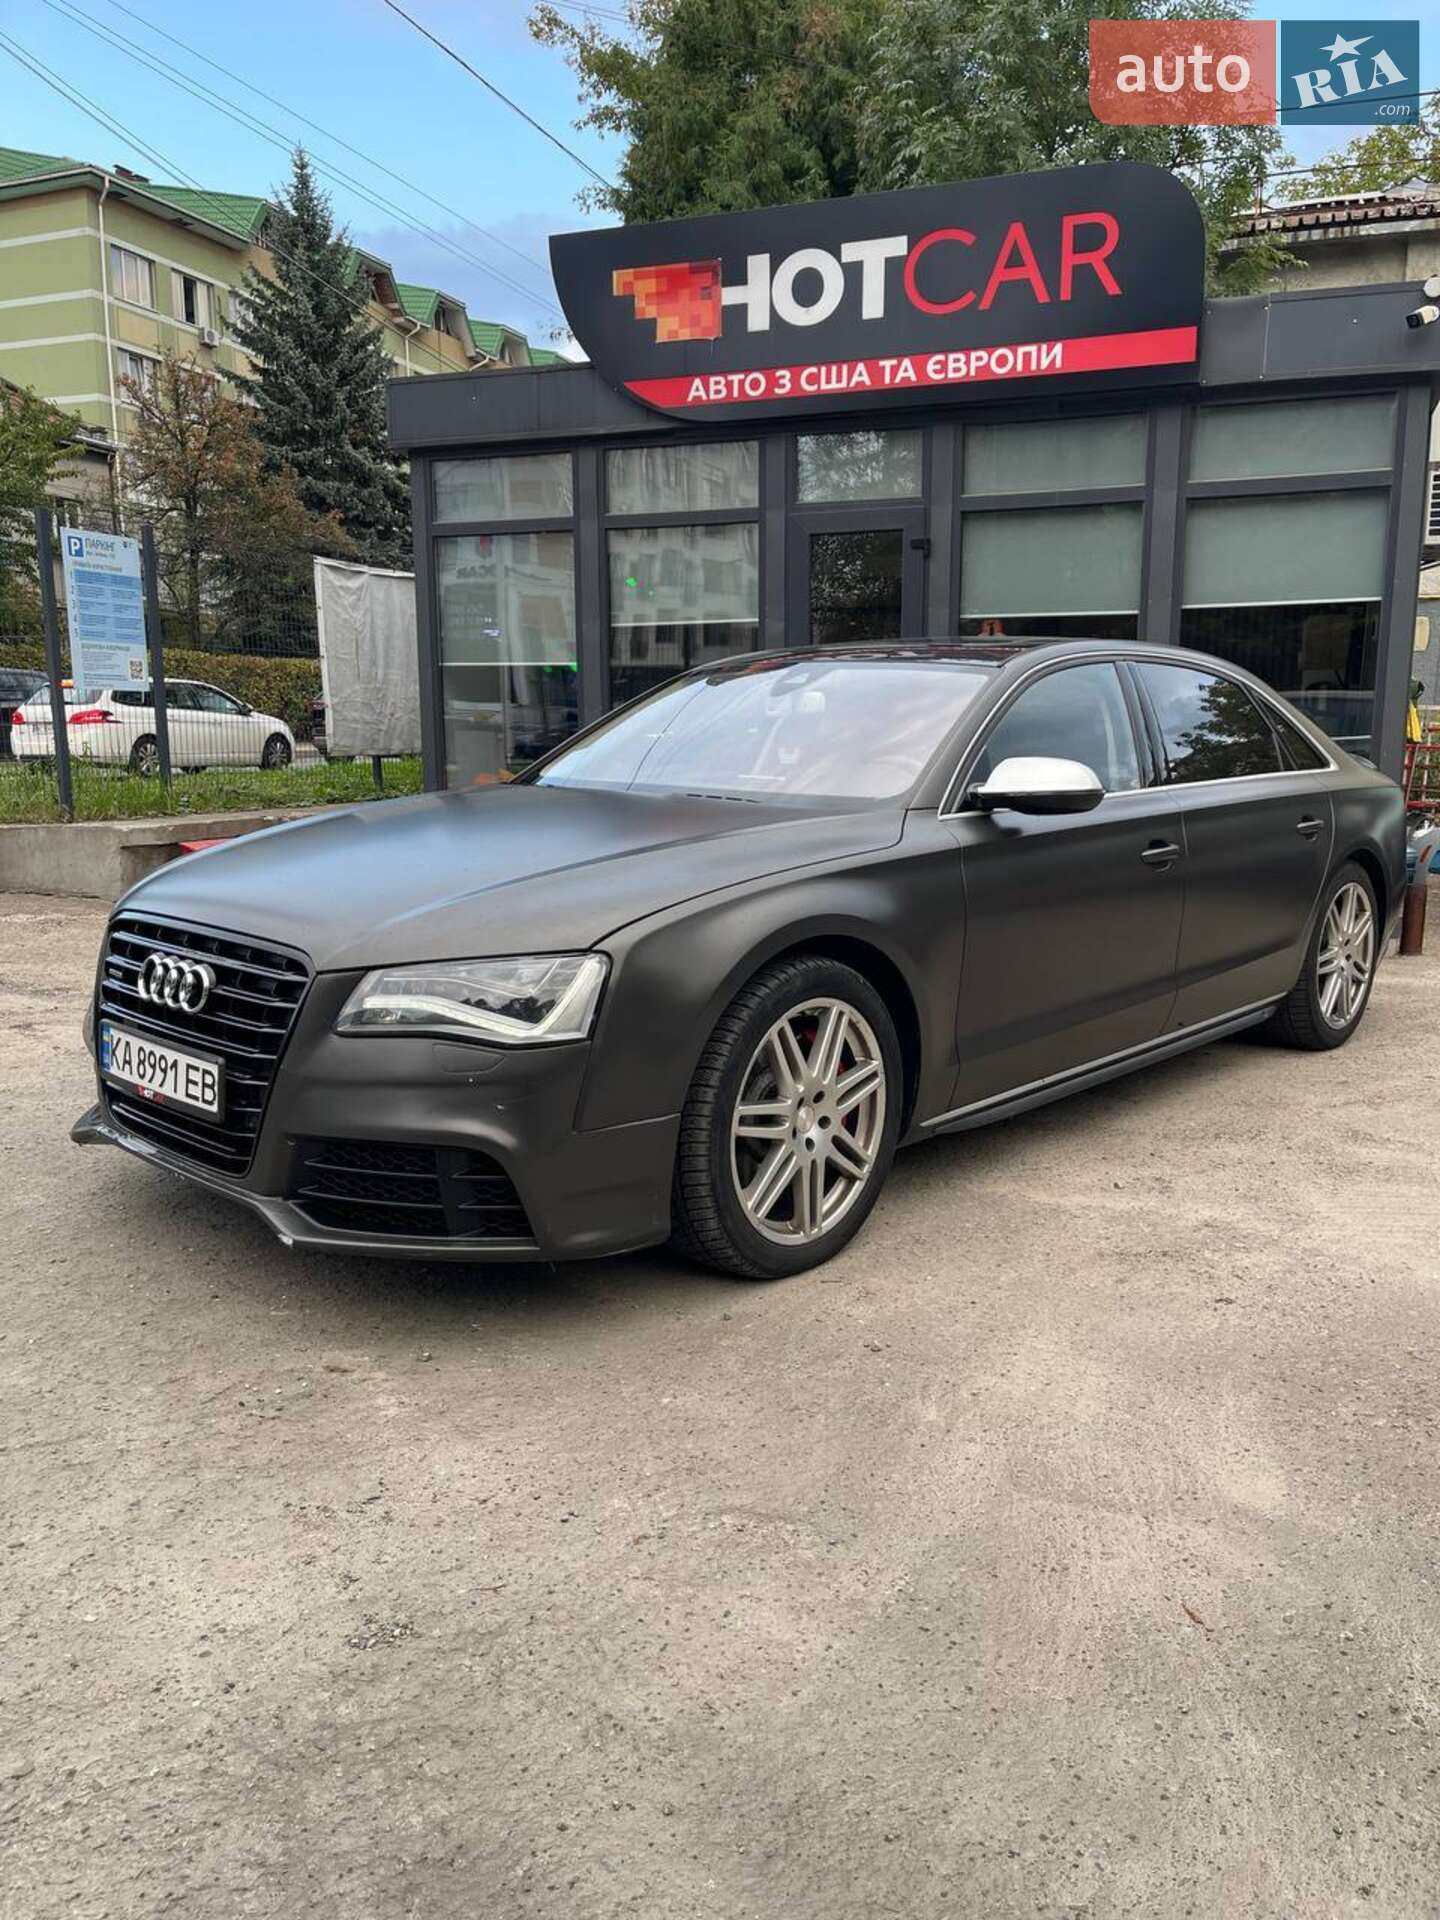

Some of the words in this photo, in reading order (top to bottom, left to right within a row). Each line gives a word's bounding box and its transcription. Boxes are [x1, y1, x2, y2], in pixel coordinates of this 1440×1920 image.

[687, 372, 766, 402] АВТО
[799, 362, 872, 392] США
[878, 357, 917, 384] ТА
[925, 343, 1063, 381] ЄВРОПИ
[110, 1034, 133, 1075] KA
[137, 1046, 178, 1094] 8991
[185, 1062, 217, 1106] EB
